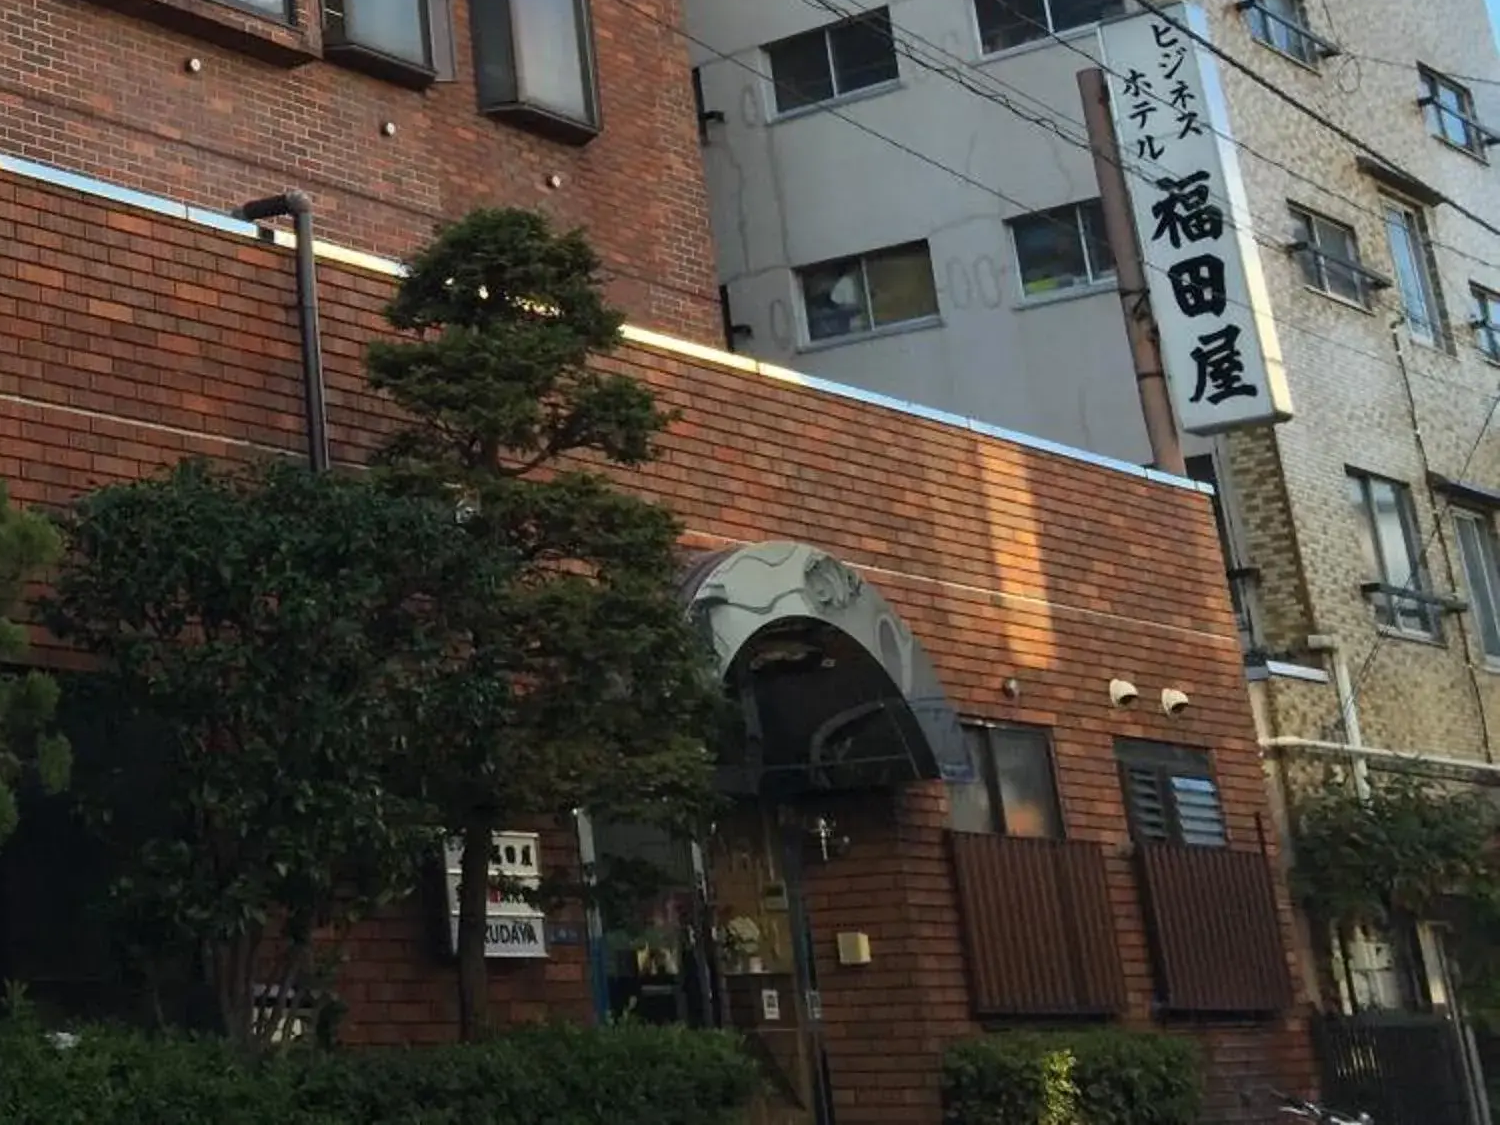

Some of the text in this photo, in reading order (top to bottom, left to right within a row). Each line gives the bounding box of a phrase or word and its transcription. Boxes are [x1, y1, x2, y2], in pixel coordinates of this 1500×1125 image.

[1123, 68, 1165, 161] ホテル
[1151, 171, 1257, 405] 福田屋
